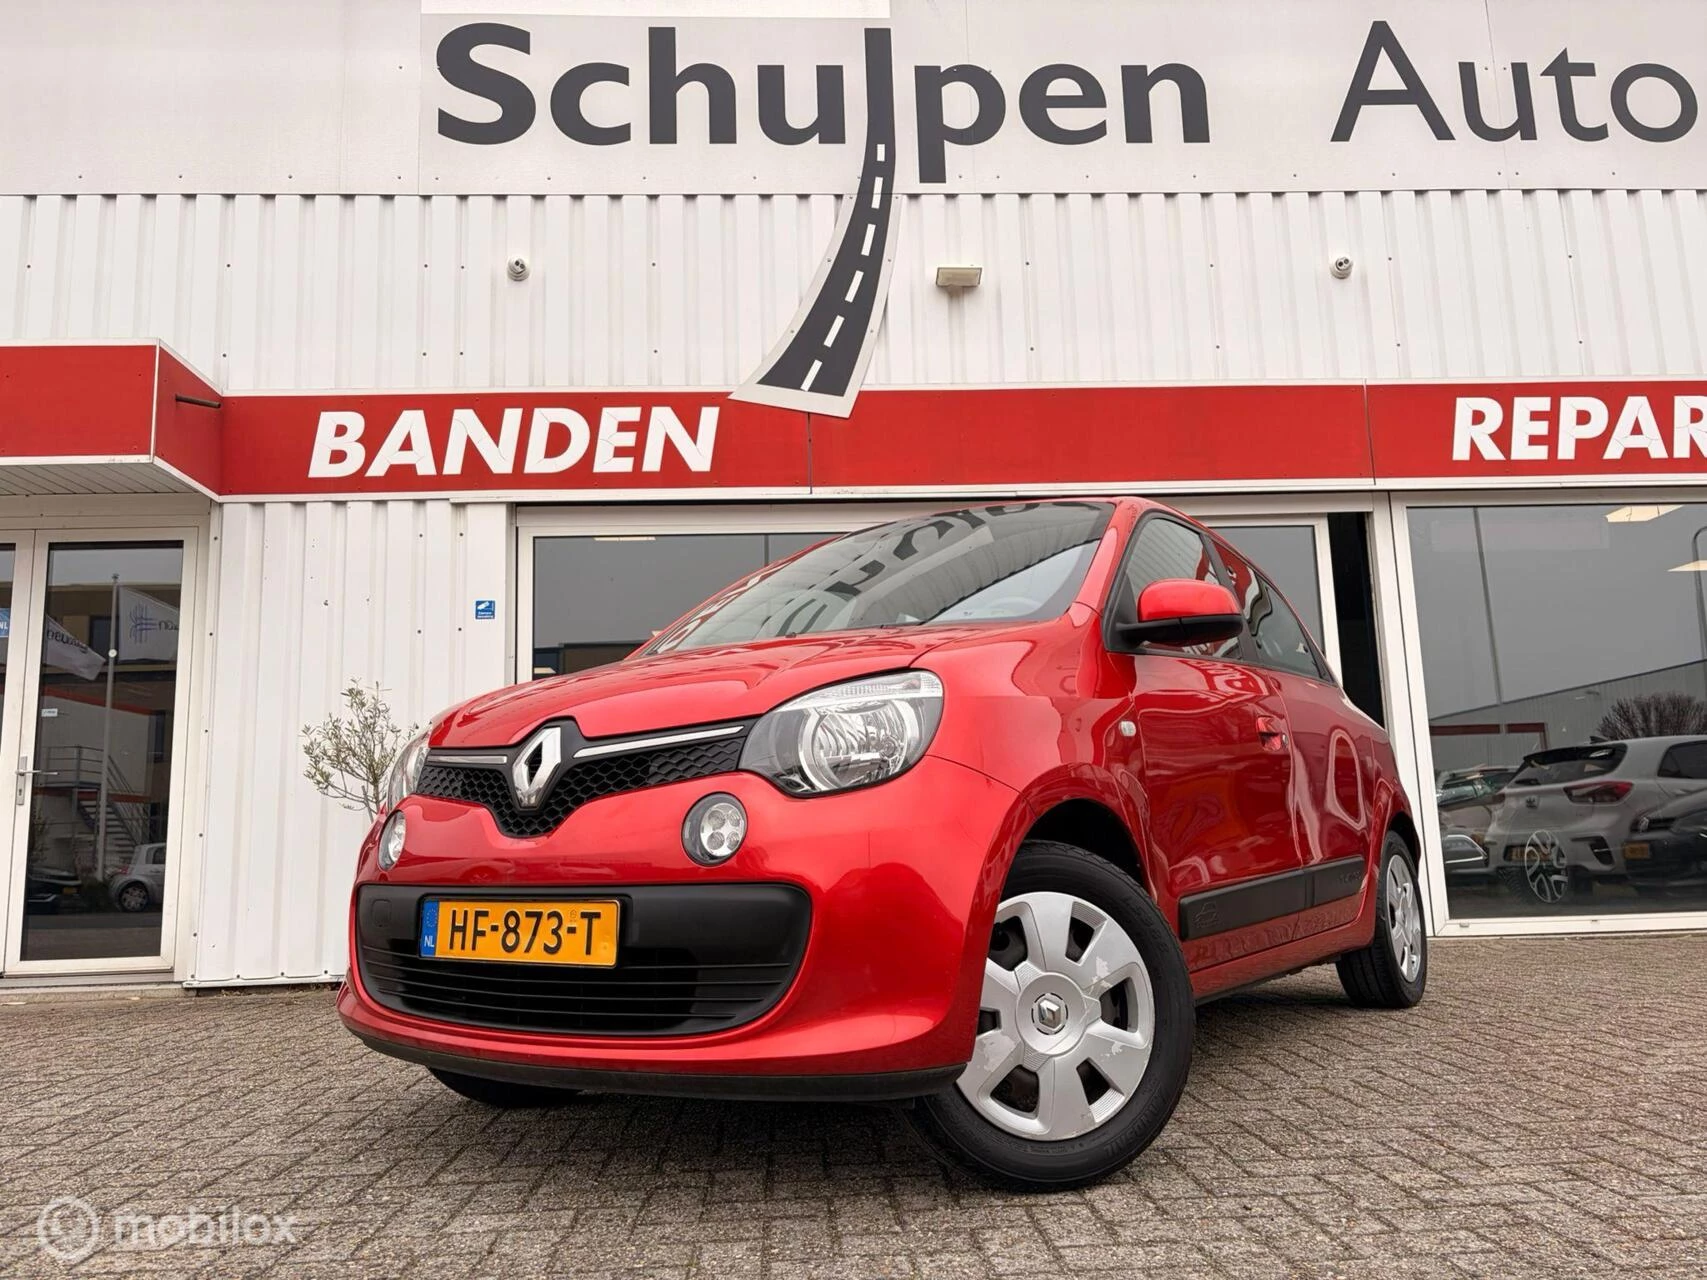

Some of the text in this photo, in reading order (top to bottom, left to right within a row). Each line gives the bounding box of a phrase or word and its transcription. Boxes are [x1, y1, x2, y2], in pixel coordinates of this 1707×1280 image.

[436, 20, 1699, 184] Schulpen Auto
[308, 406, 721, 479] BANDEN
[424, 909, 602, 956] NL HF-873-T
